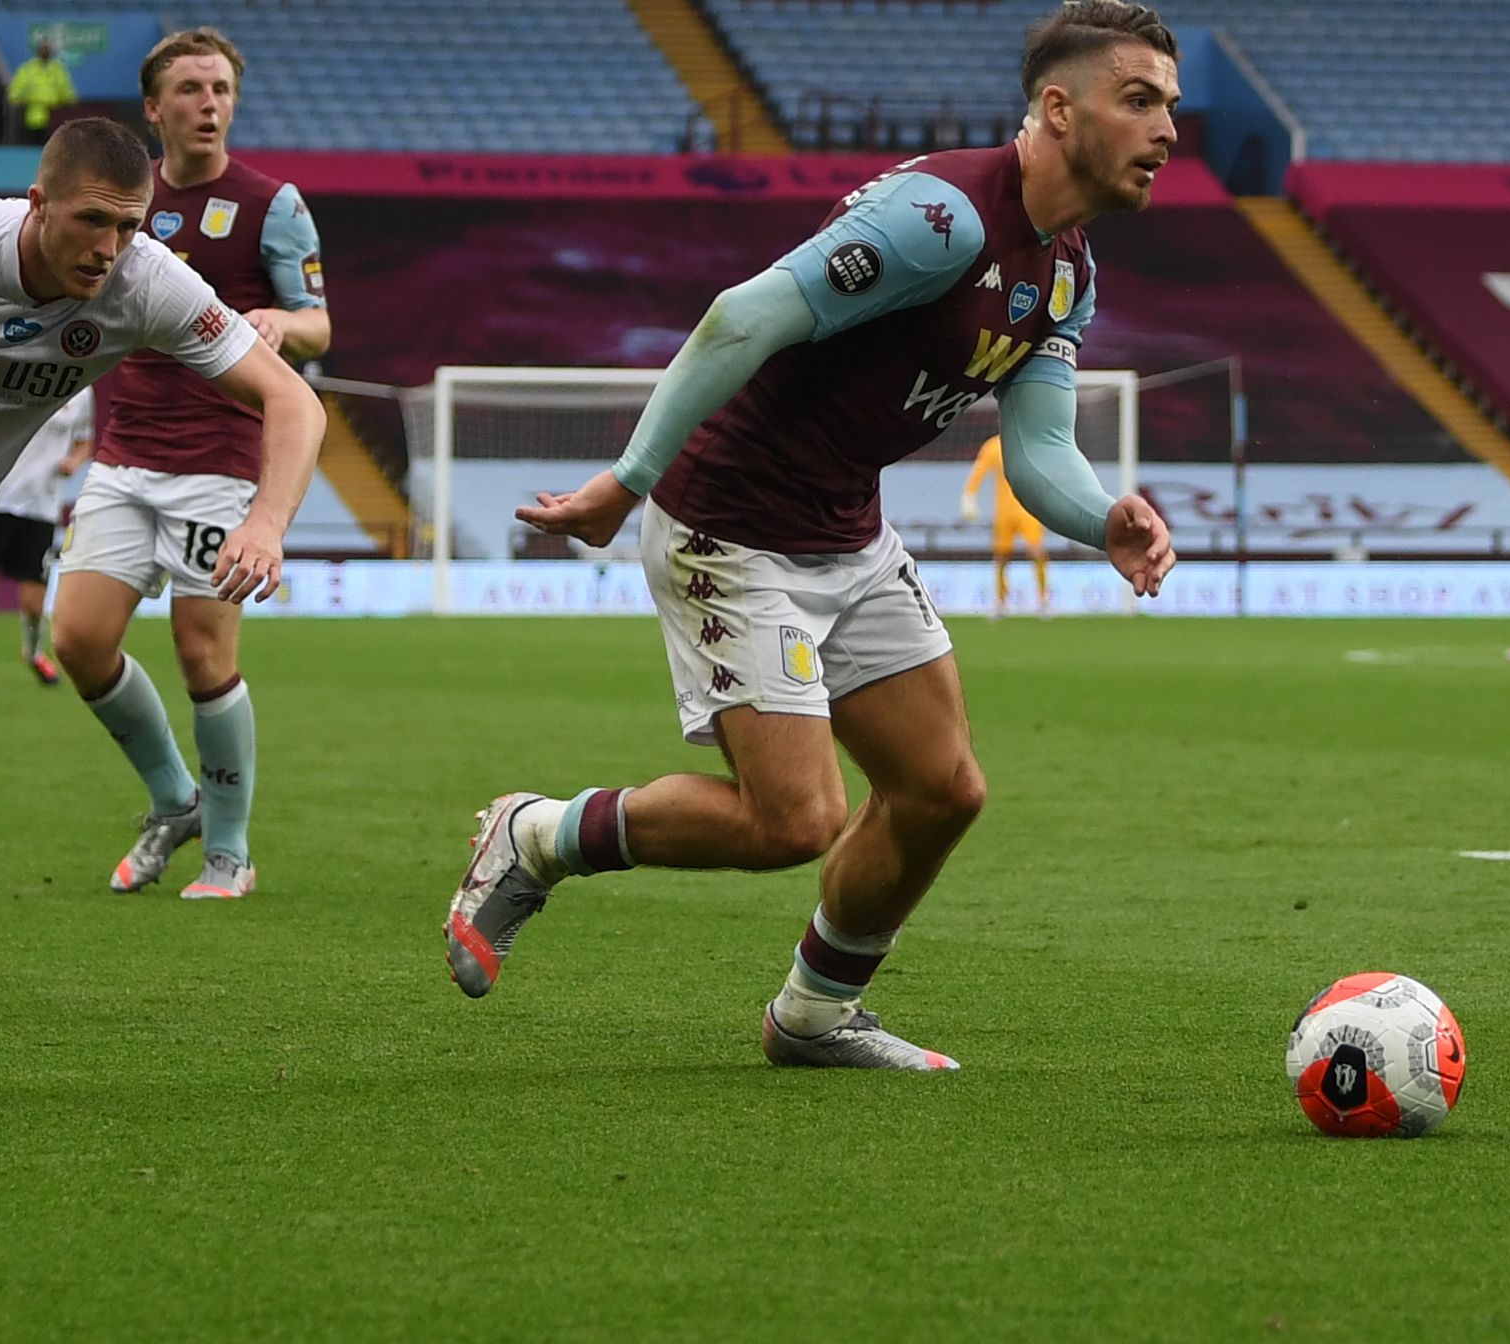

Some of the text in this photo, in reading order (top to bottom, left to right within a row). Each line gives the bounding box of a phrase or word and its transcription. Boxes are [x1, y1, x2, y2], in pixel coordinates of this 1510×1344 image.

[418, 161, 658, 186] Premier
[830, 255, 857, 293] MATTER
[843, 254, 865, 282] LIVES
[1015, 294, 1032, 310] NHS
[2, 361, 83, 398] USG
[183, 520, 227, 573] 18
[783, 629, 813, 646] AVFC
